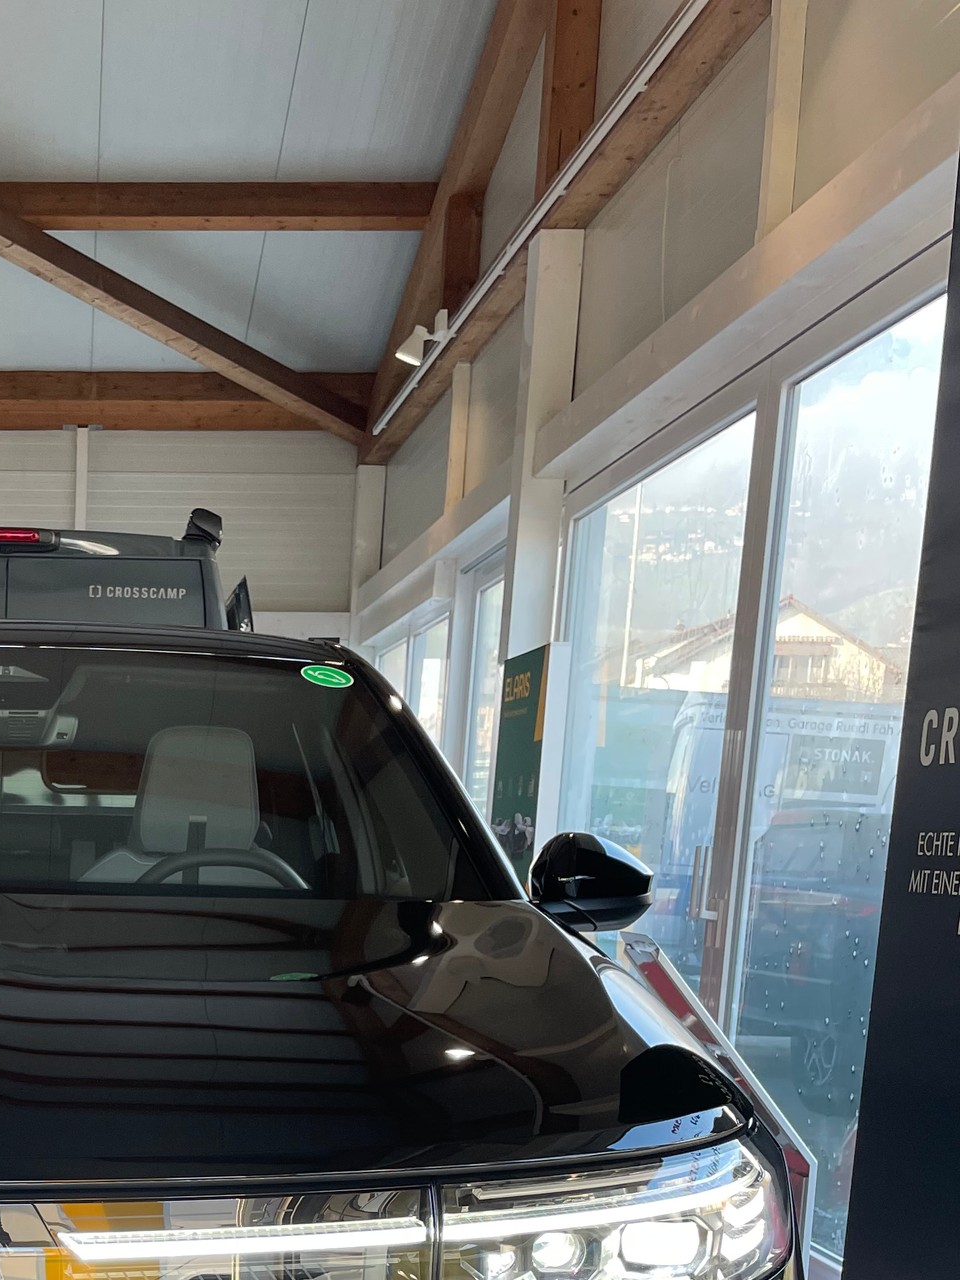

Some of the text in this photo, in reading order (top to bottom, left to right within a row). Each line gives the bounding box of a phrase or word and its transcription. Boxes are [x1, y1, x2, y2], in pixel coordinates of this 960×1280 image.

[106, 586, 187, 599] CROSSCAMP
[504, 671, 531, 703] ELARIS
[917, 831, 955, 856] ECHTE
[908, 868, 960, 896] MIT EINE
